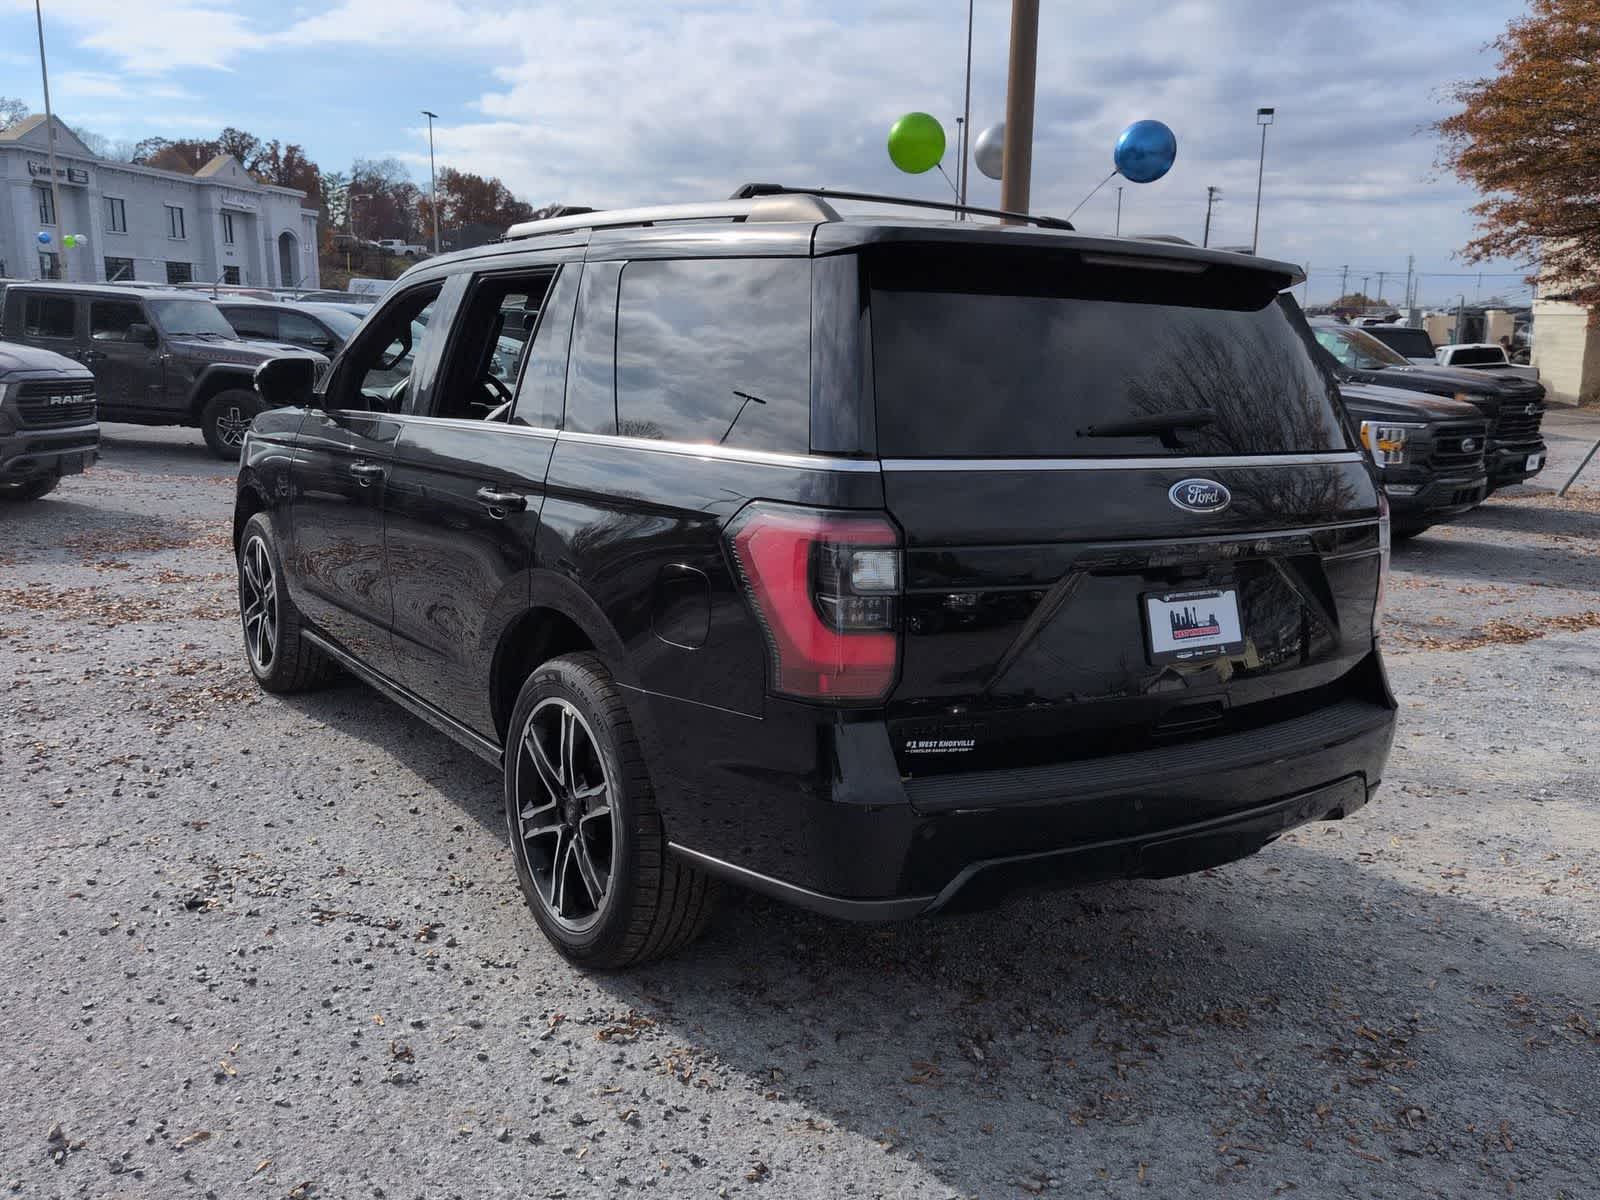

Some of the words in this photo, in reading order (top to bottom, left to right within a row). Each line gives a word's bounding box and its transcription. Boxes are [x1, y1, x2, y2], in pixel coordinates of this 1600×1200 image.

[50, 395, 83, 405] RAM
[1187, 485, 1219, 504] Ford
[938, 739, 975, 748] KNOXVILLE
